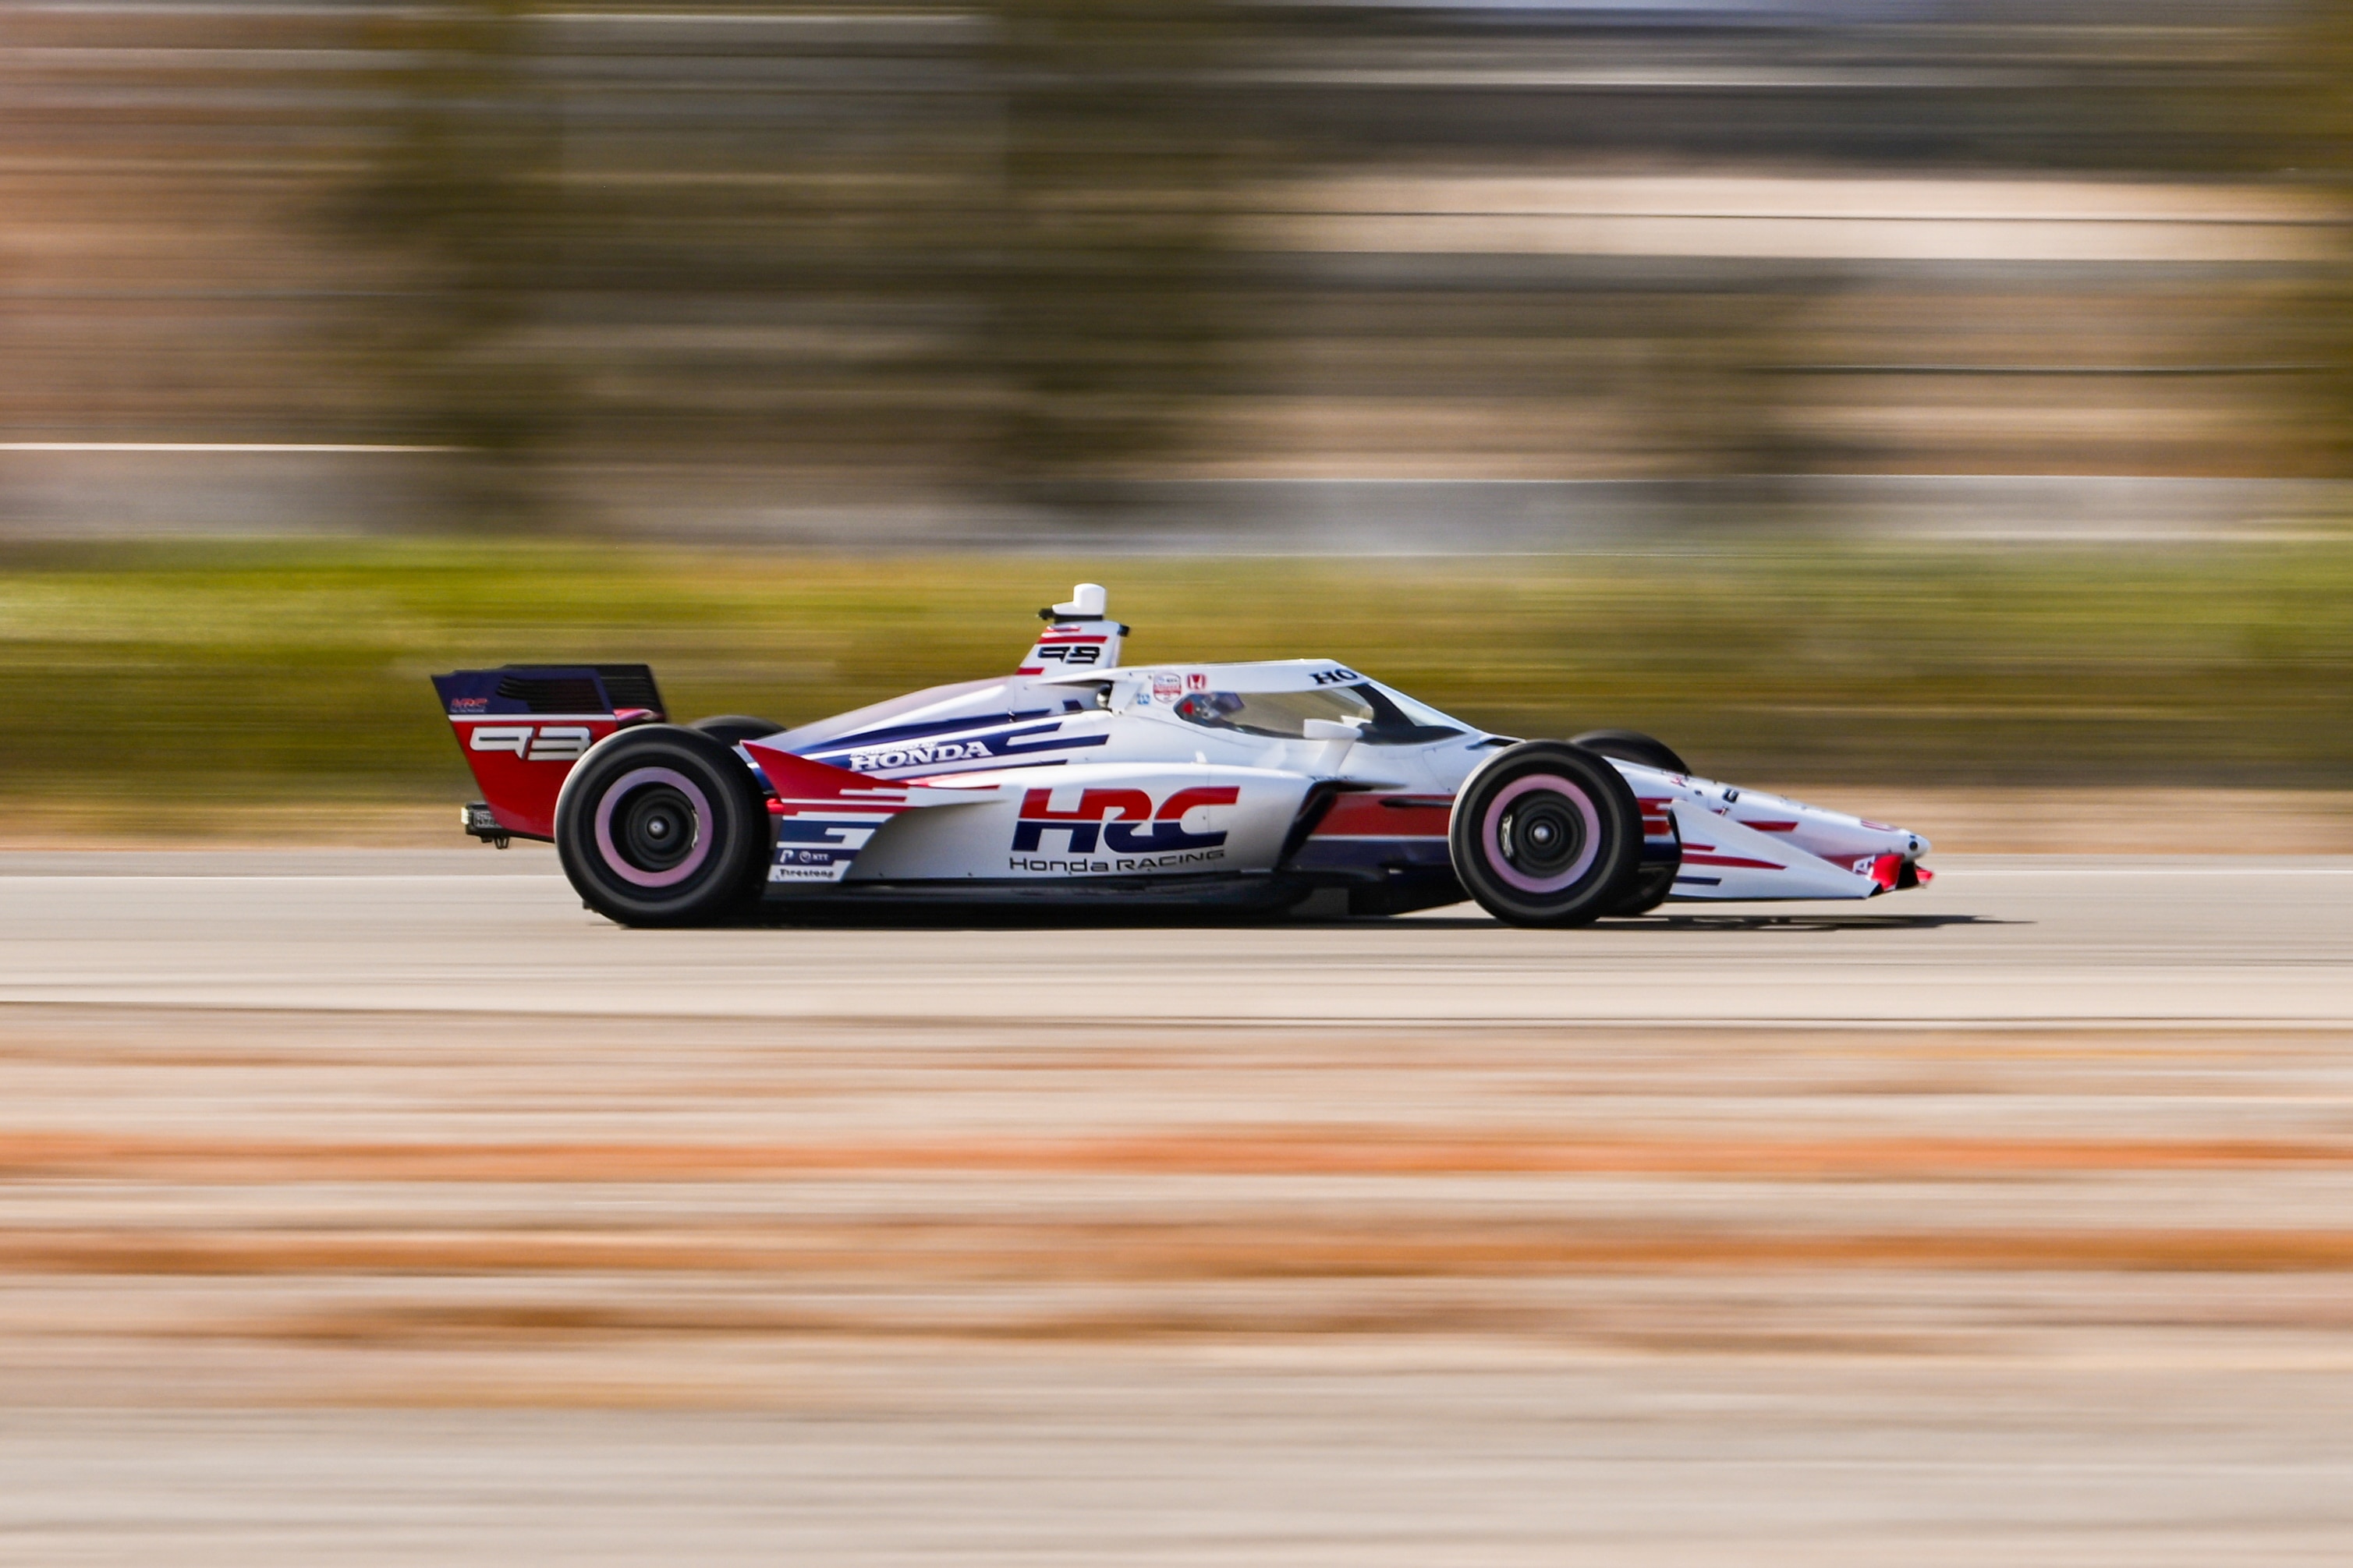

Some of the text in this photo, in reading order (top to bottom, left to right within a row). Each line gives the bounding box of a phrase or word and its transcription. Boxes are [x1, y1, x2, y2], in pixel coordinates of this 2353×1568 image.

[470, 726, 591, 760] 93
[849, 741, 994, 771] HONDA
[1011, 786, 1240, 853] HRC
[780, 869, 834, 878] Firestone
[1010, 849, 1225, 872] Honda RACING
